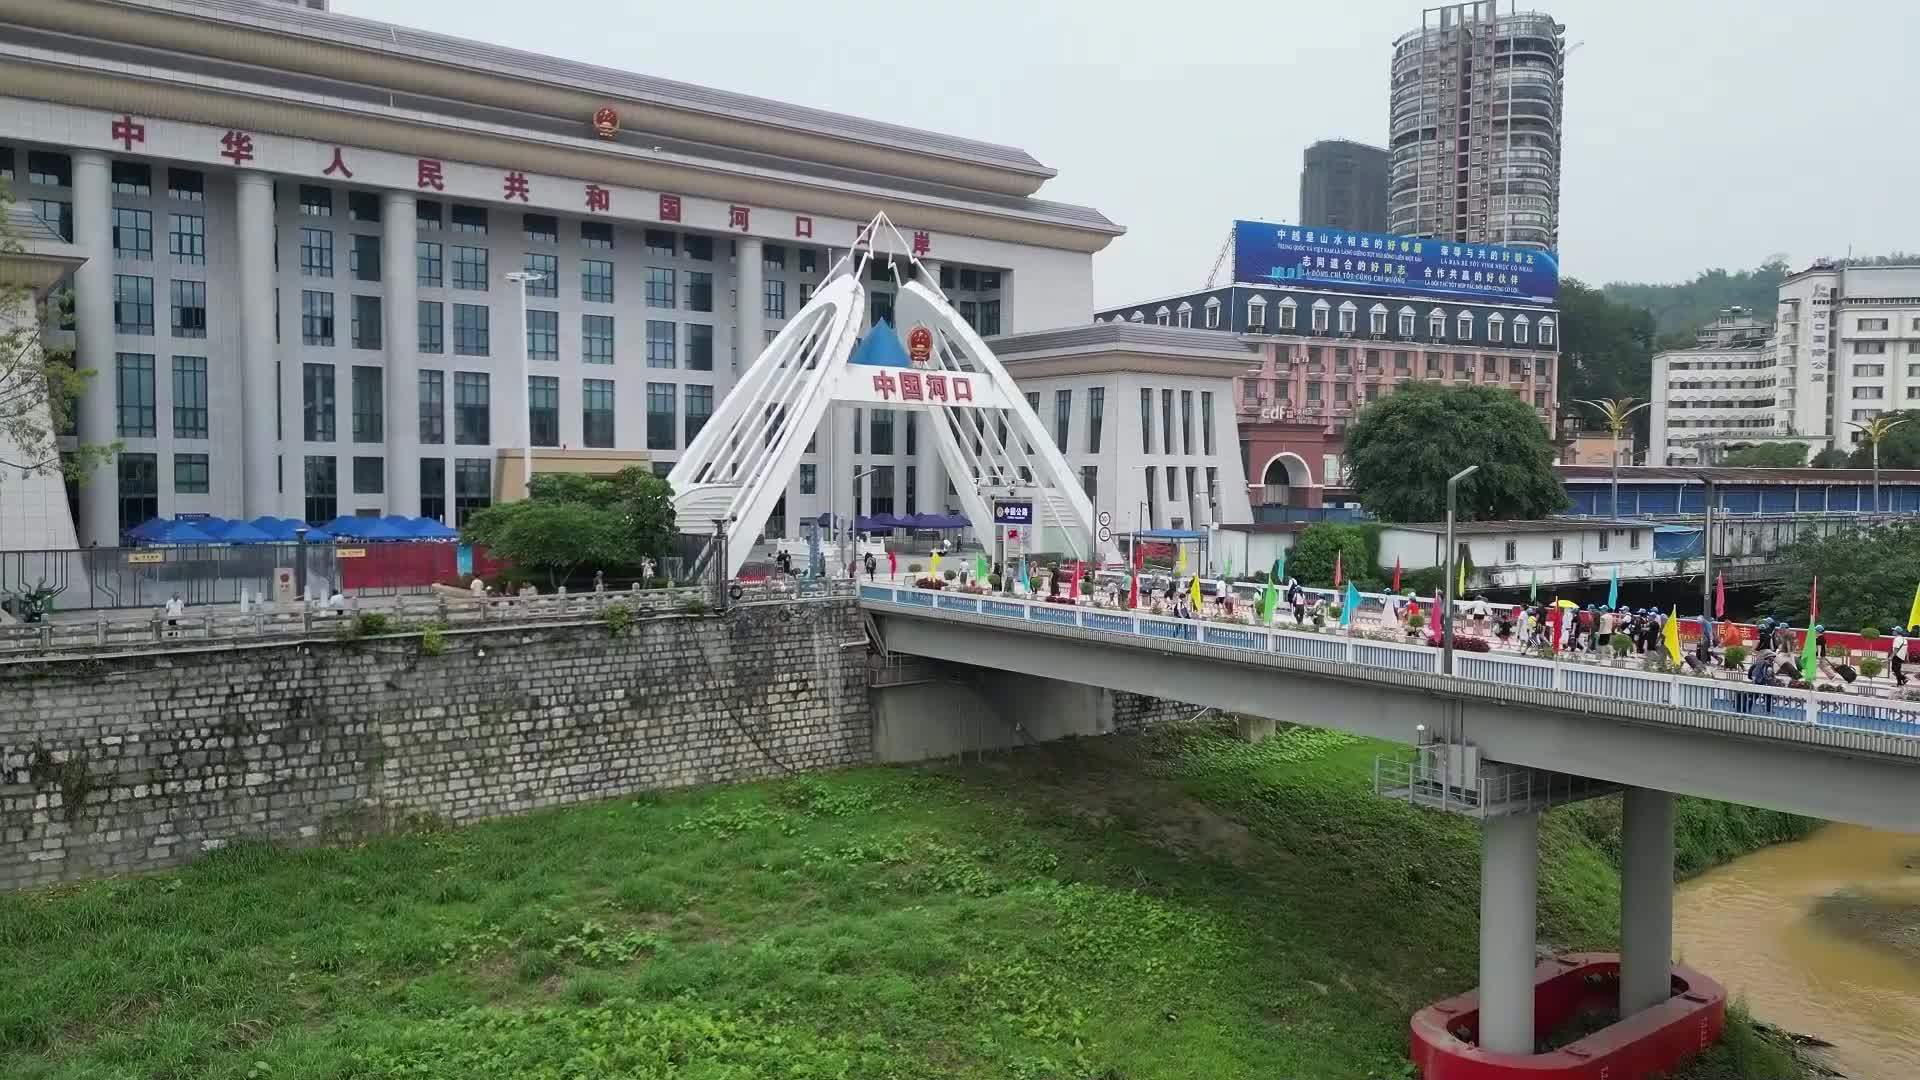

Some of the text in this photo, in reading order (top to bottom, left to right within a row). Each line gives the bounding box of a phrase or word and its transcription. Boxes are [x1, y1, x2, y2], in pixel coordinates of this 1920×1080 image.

[112, 115, 930, 257] 中华人民共和国河口口岸
[873, 370, 974, 402] 中国河口
